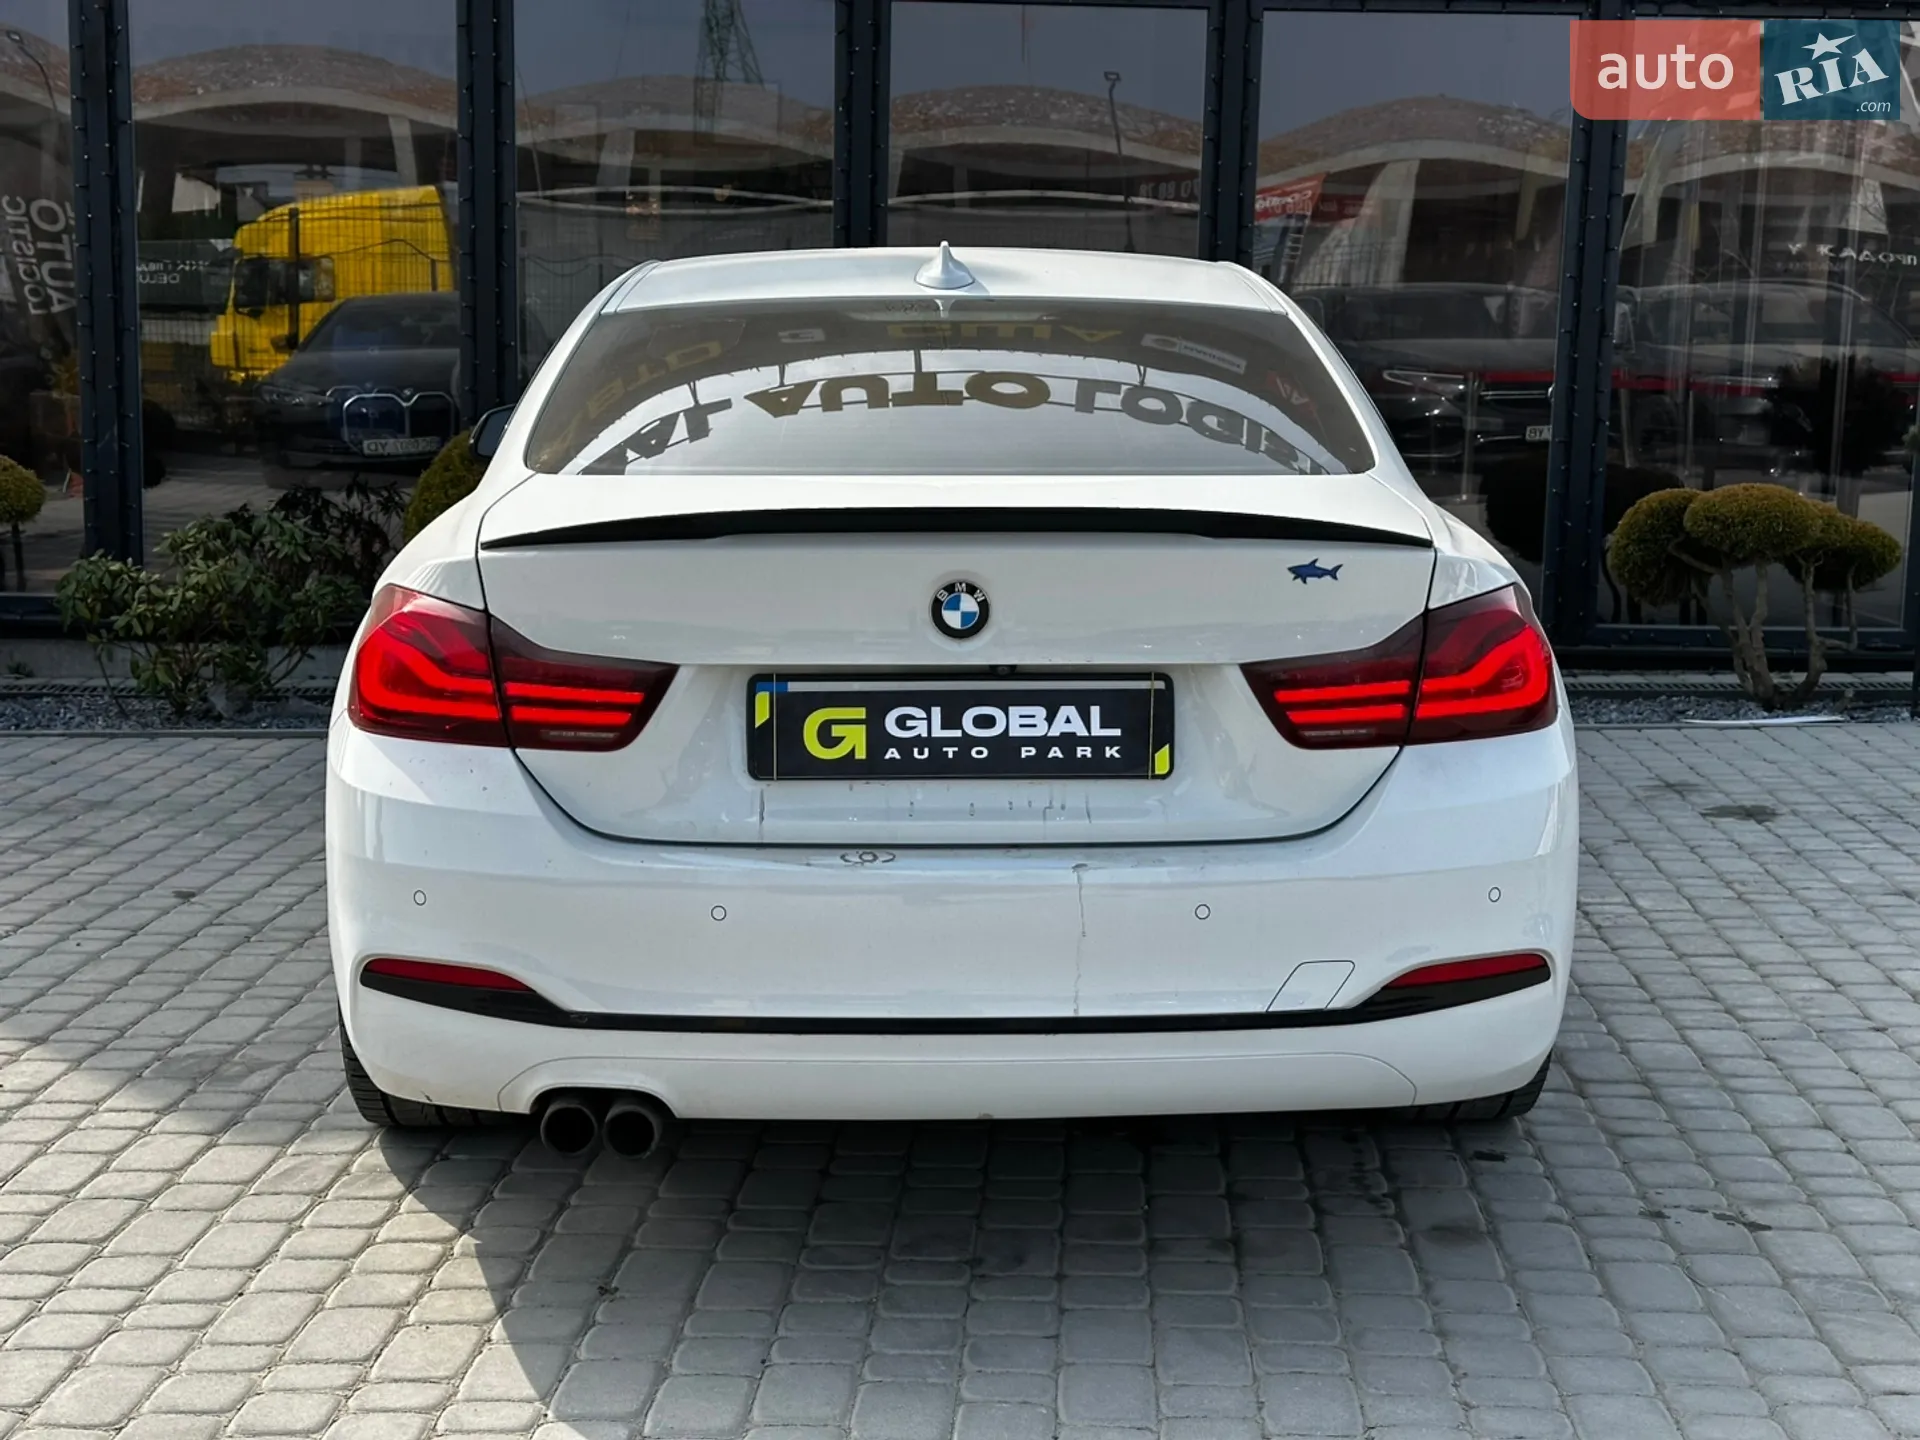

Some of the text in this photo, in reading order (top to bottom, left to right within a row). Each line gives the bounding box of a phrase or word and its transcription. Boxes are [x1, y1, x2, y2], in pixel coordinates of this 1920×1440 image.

[936, 582, 986, 602] BMW
[884, 705, 1122, 738] GLOBAL
[884, 746, 1122, 759] AUTO PARK
